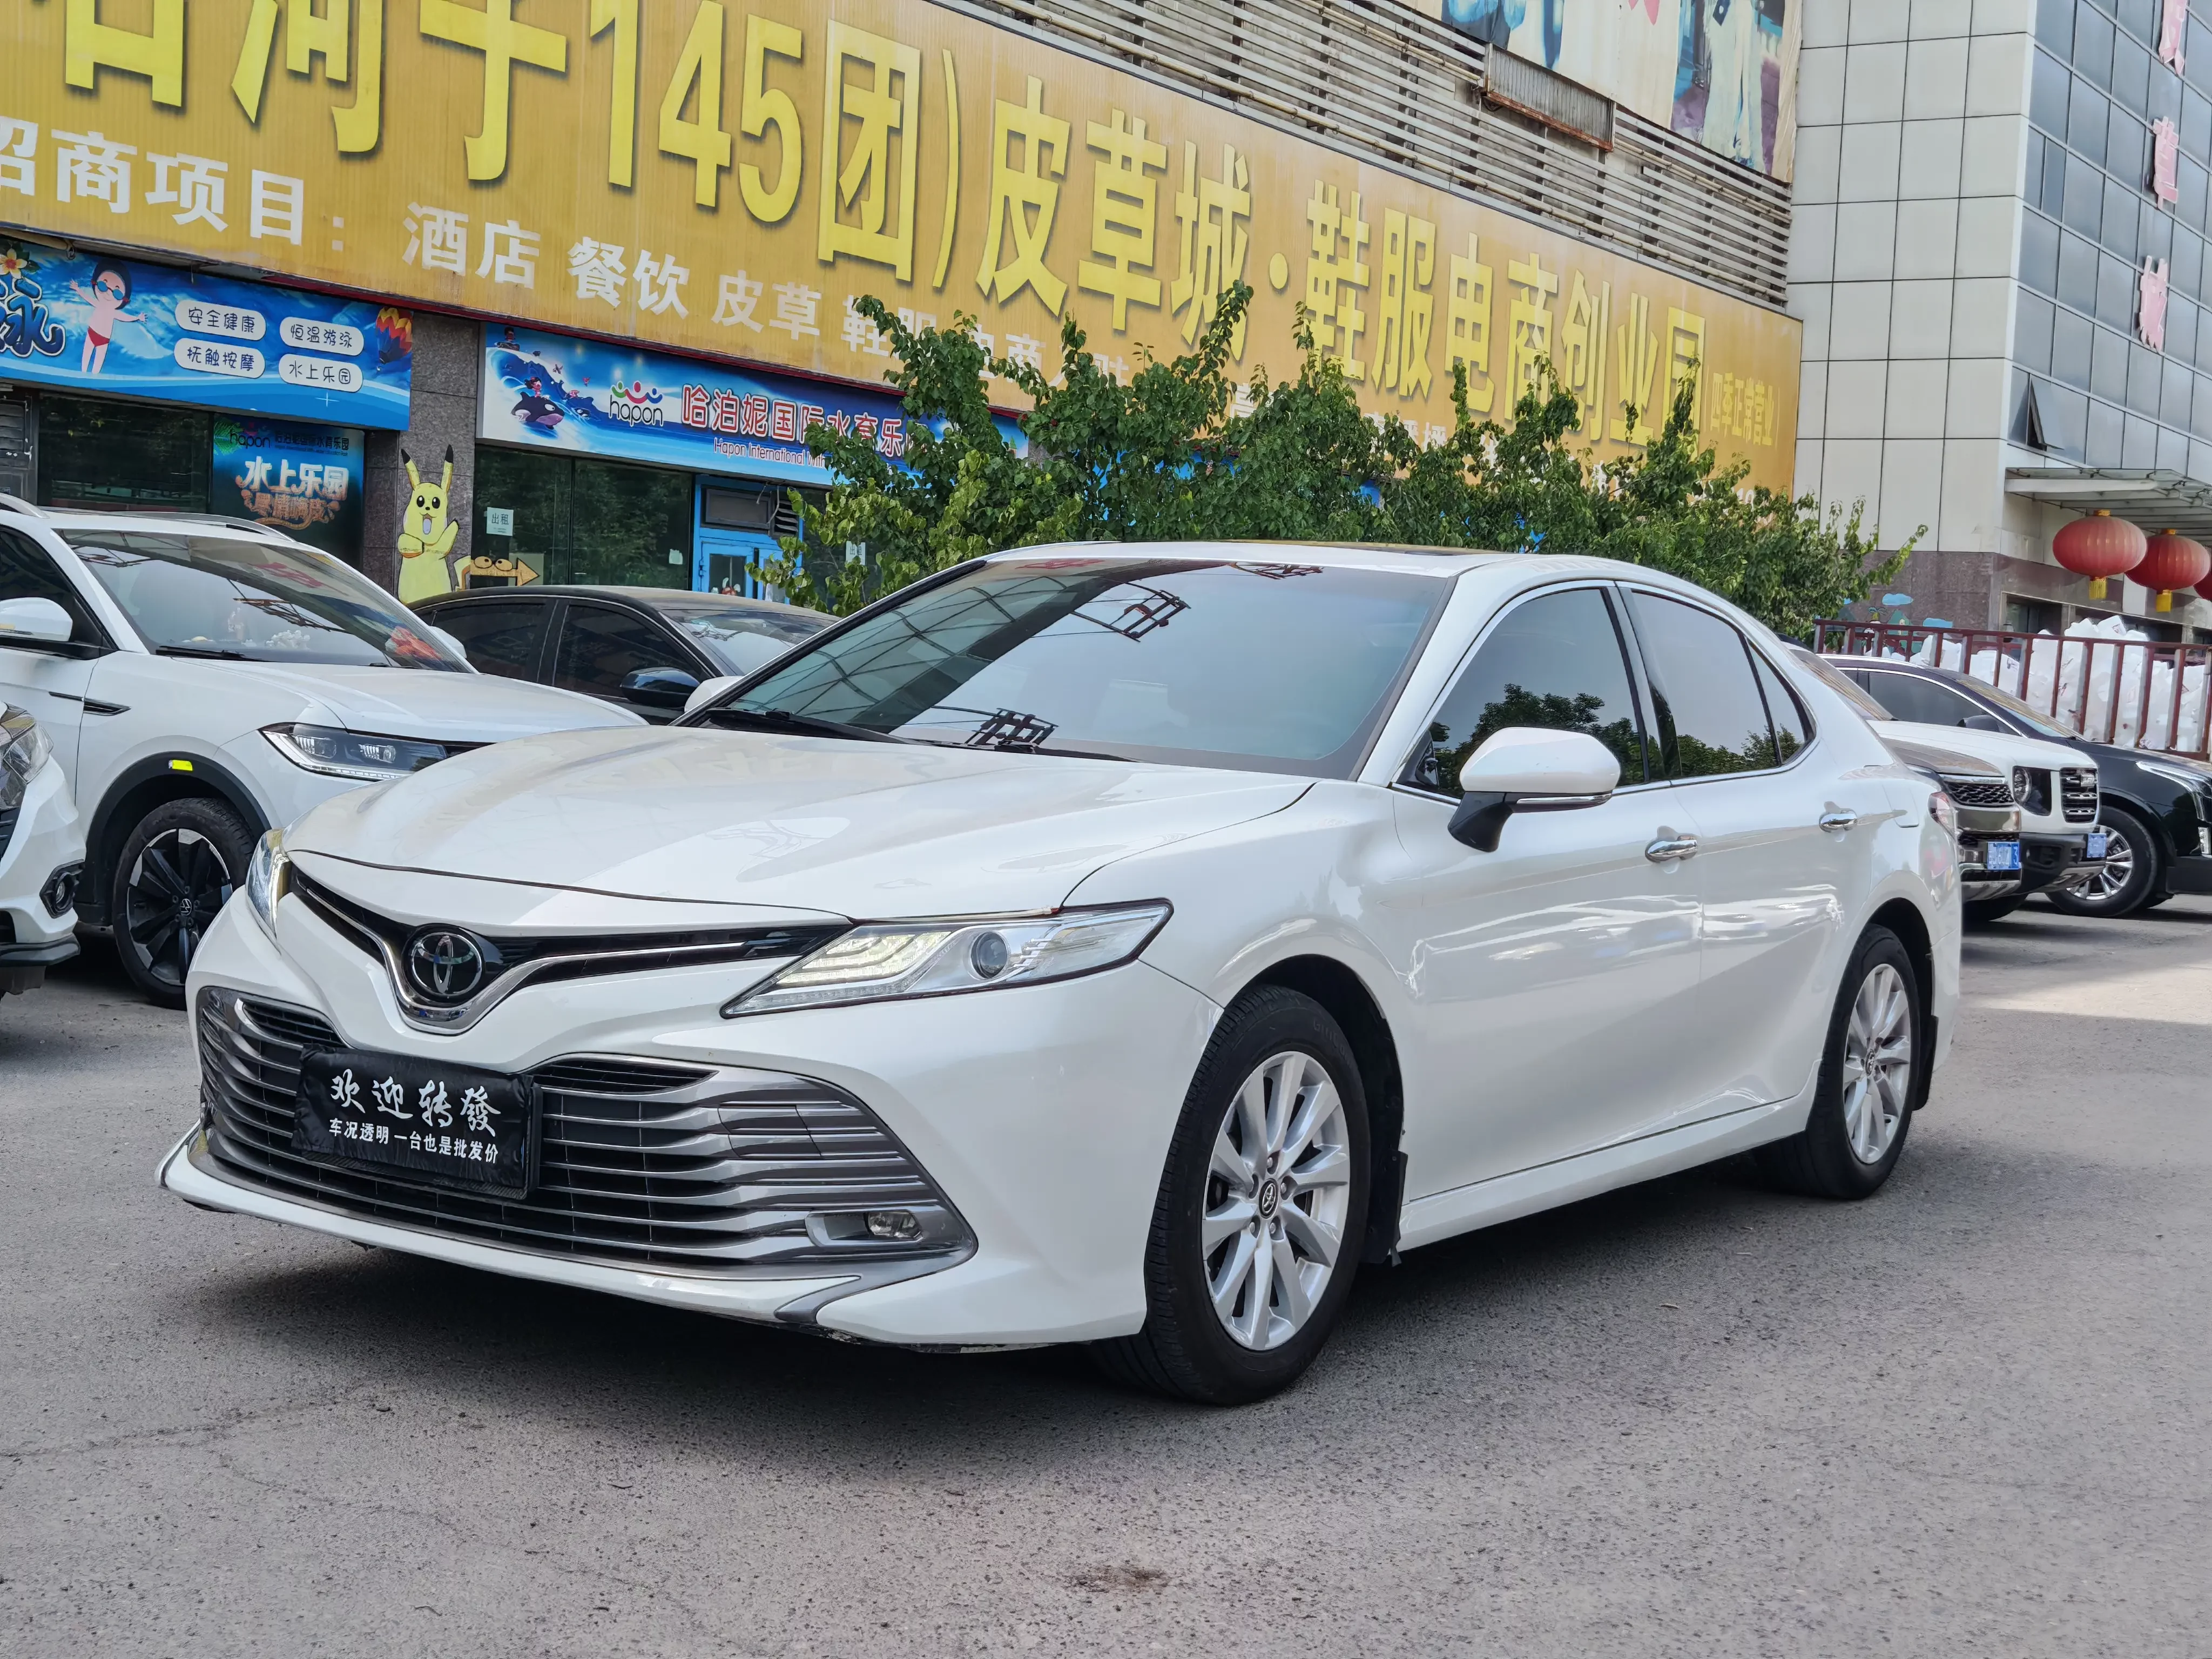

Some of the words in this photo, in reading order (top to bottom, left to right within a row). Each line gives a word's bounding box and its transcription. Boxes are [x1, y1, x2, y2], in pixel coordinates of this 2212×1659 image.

[402, 202, 540, 289] 酒店
[567, 235, 690, 319] 餐饮
[712, 270, 821, 340] 皮草
[188, 306, 255, 333] 安全健康
[291, 324, 353, 348] 恒温游泳
[187, 346, 254, 371] 抚触按摩
[289, 360, 351, 385] 水上乐园
[609, 394, 664, 427] hapon
[682, 384, 928, 458] 哈泊妮国际水育乐
[230, 429, 270, 449] hapon
[714, 437, 747, 458] Hapon
[749, 442, 805, 466] International
[242, 456, 349, 501] 水上乐园
[491, 512, 509, 525] 出租
[329, 1117, 389, 1144] 车况透明
[394, 1131, 498, 1164] 一台也是批发价
